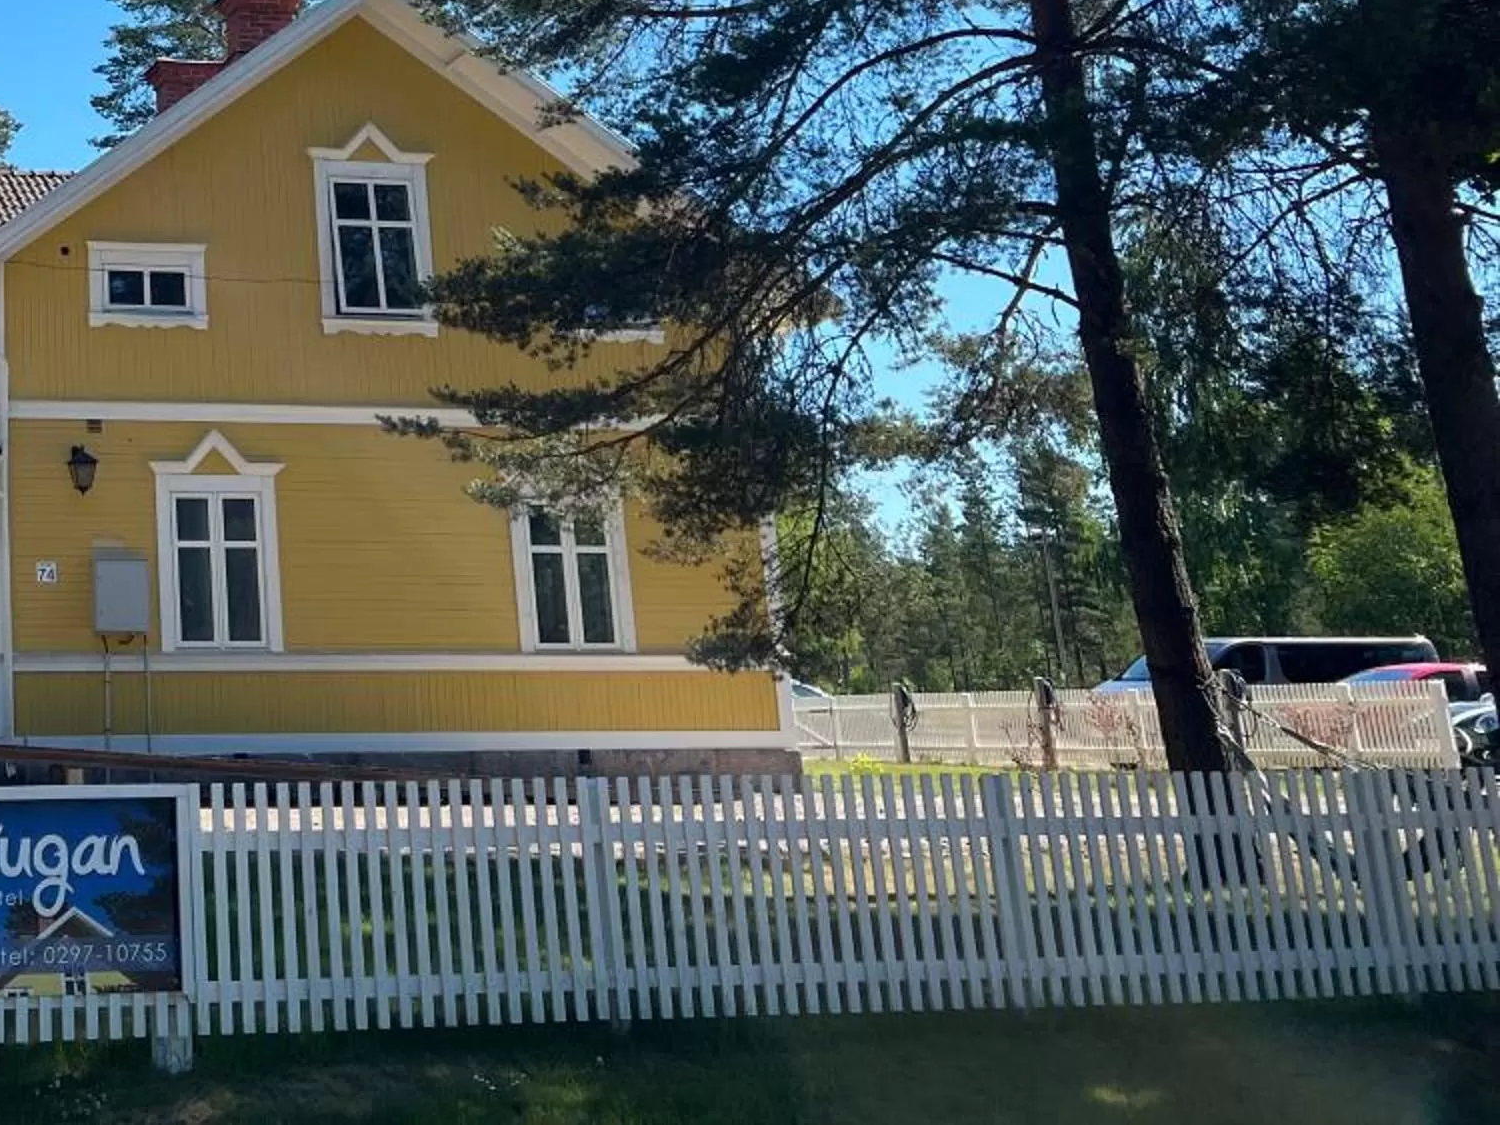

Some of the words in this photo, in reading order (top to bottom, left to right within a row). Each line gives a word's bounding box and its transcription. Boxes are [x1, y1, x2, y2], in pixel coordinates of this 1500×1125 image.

[37, 567, 54, 580] 74
[0, 947, 36, 966] tel:
[42, 942, 168, 965] 0297-10755
